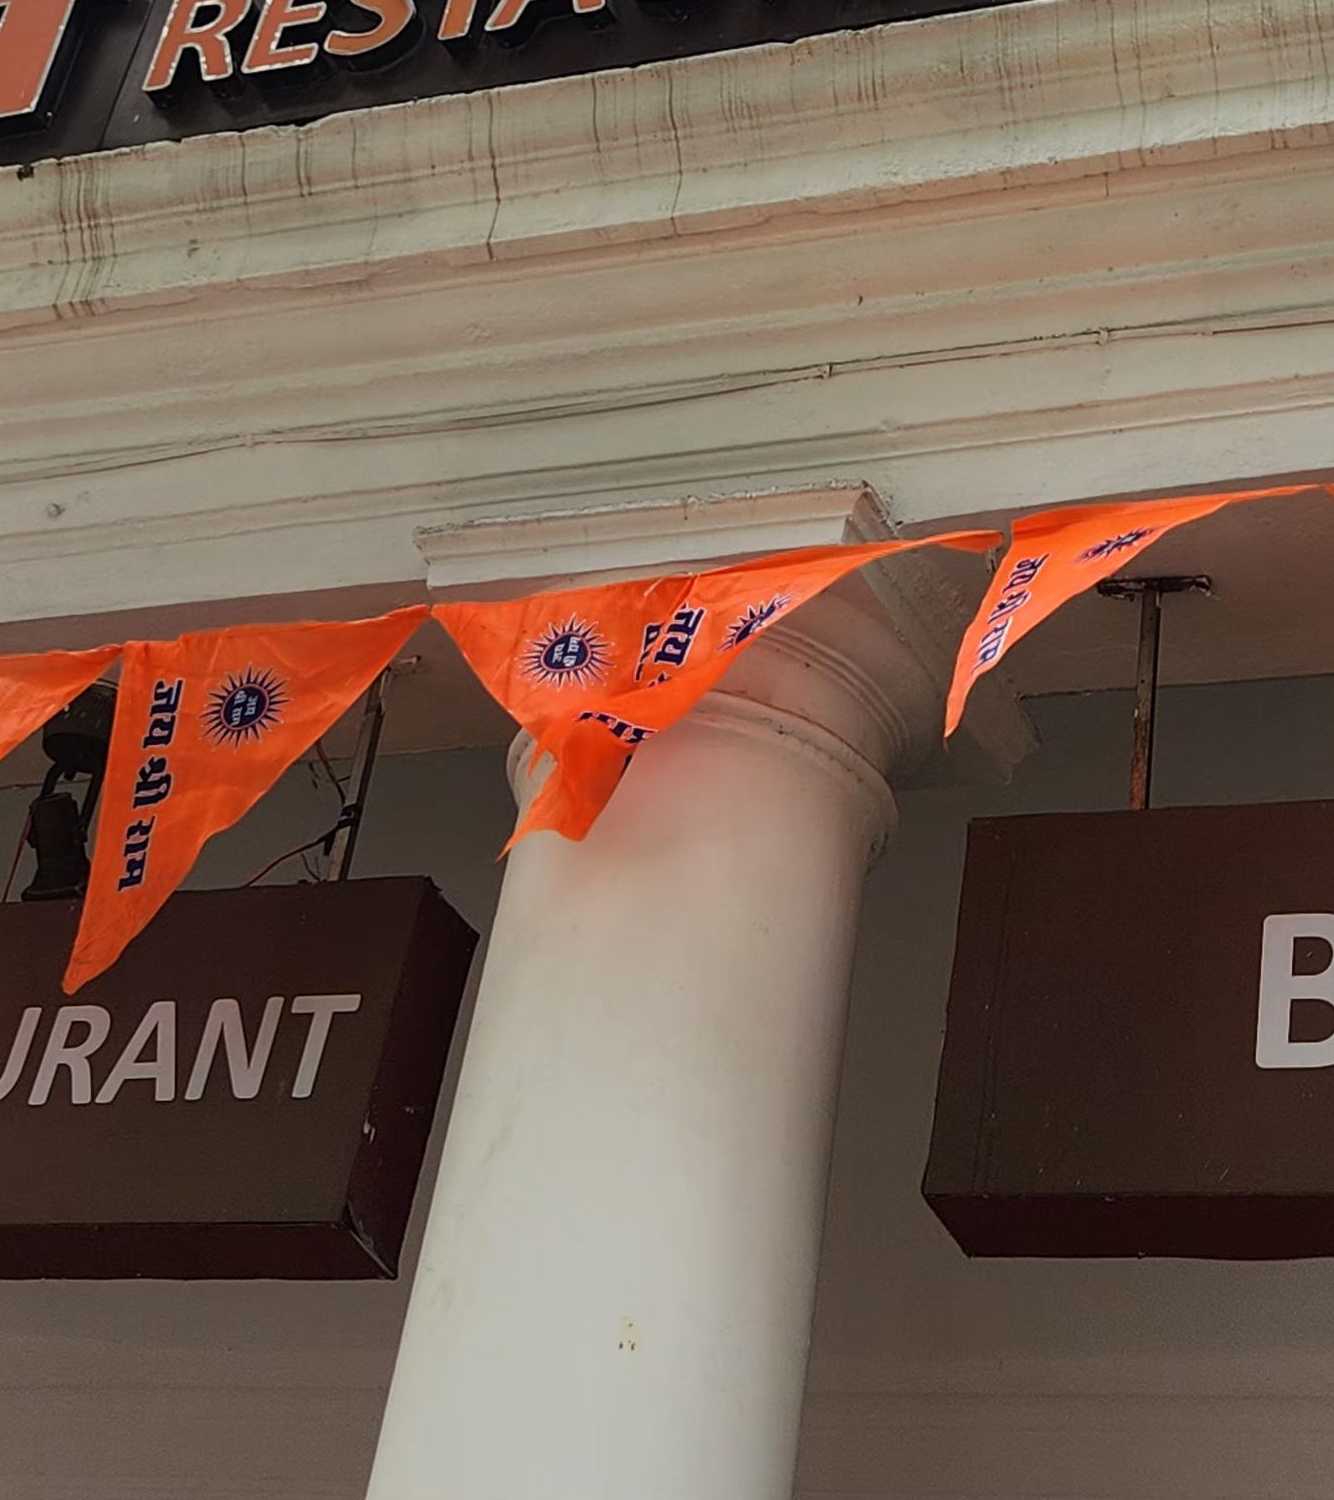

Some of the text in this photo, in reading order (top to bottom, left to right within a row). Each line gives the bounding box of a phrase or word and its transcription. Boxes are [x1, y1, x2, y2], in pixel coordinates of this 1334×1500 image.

[117, 678, 184, 893] जय श्री राम
